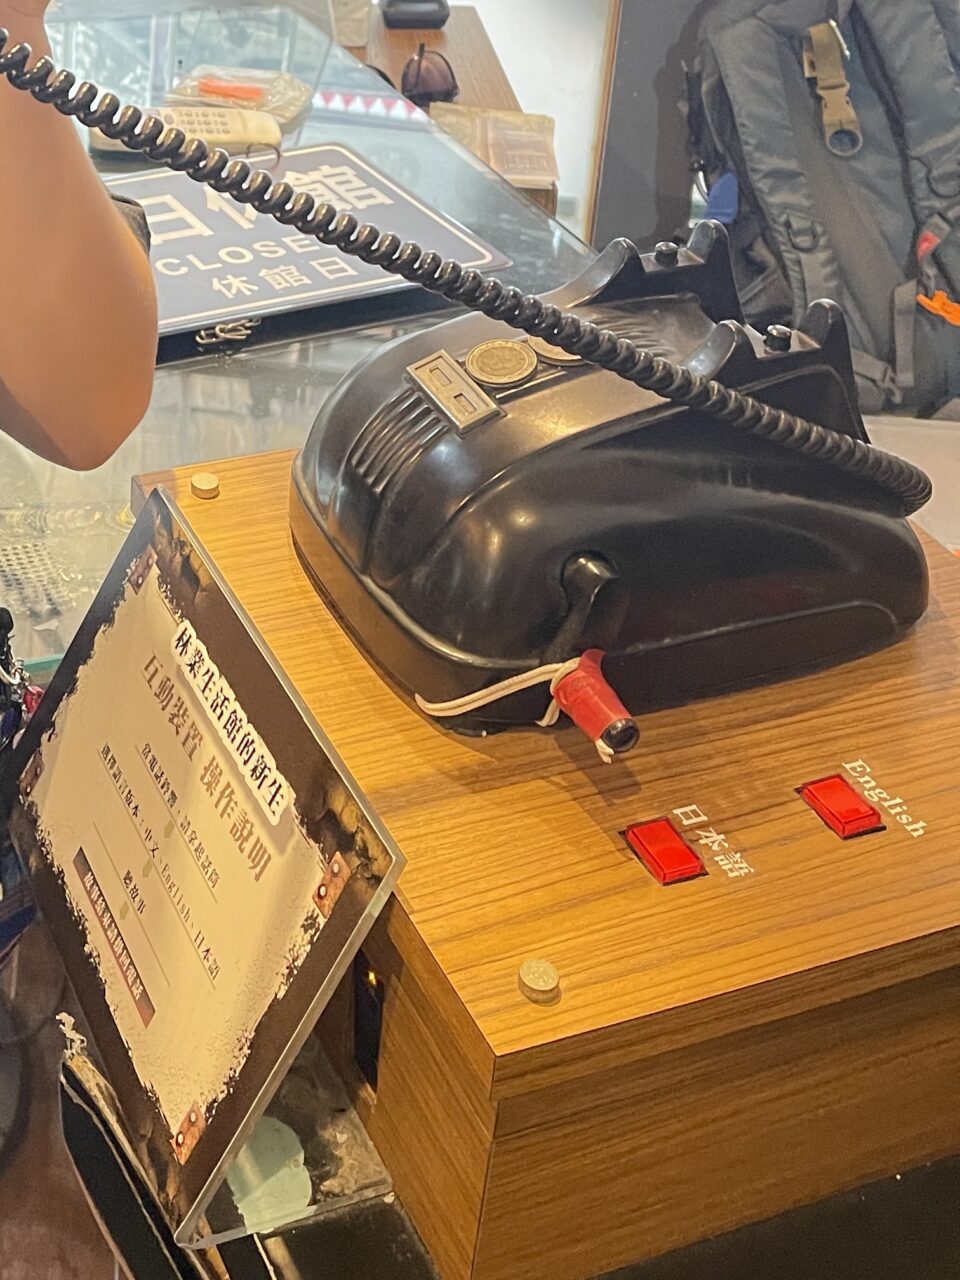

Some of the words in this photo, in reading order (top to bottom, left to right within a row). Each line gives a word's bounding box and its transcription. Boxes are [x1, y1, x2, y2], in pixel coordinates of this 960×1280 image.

[212, 255, 359, 299] 休館日
[174, 626, 285, 817] 林業生活館的新生
[142, 652, 205, 762] 互動裝置
[199, 754, 272, 883] 操作說明
[841, 758, 926, 839] English
[672, 803, 755, 878] 日本語
